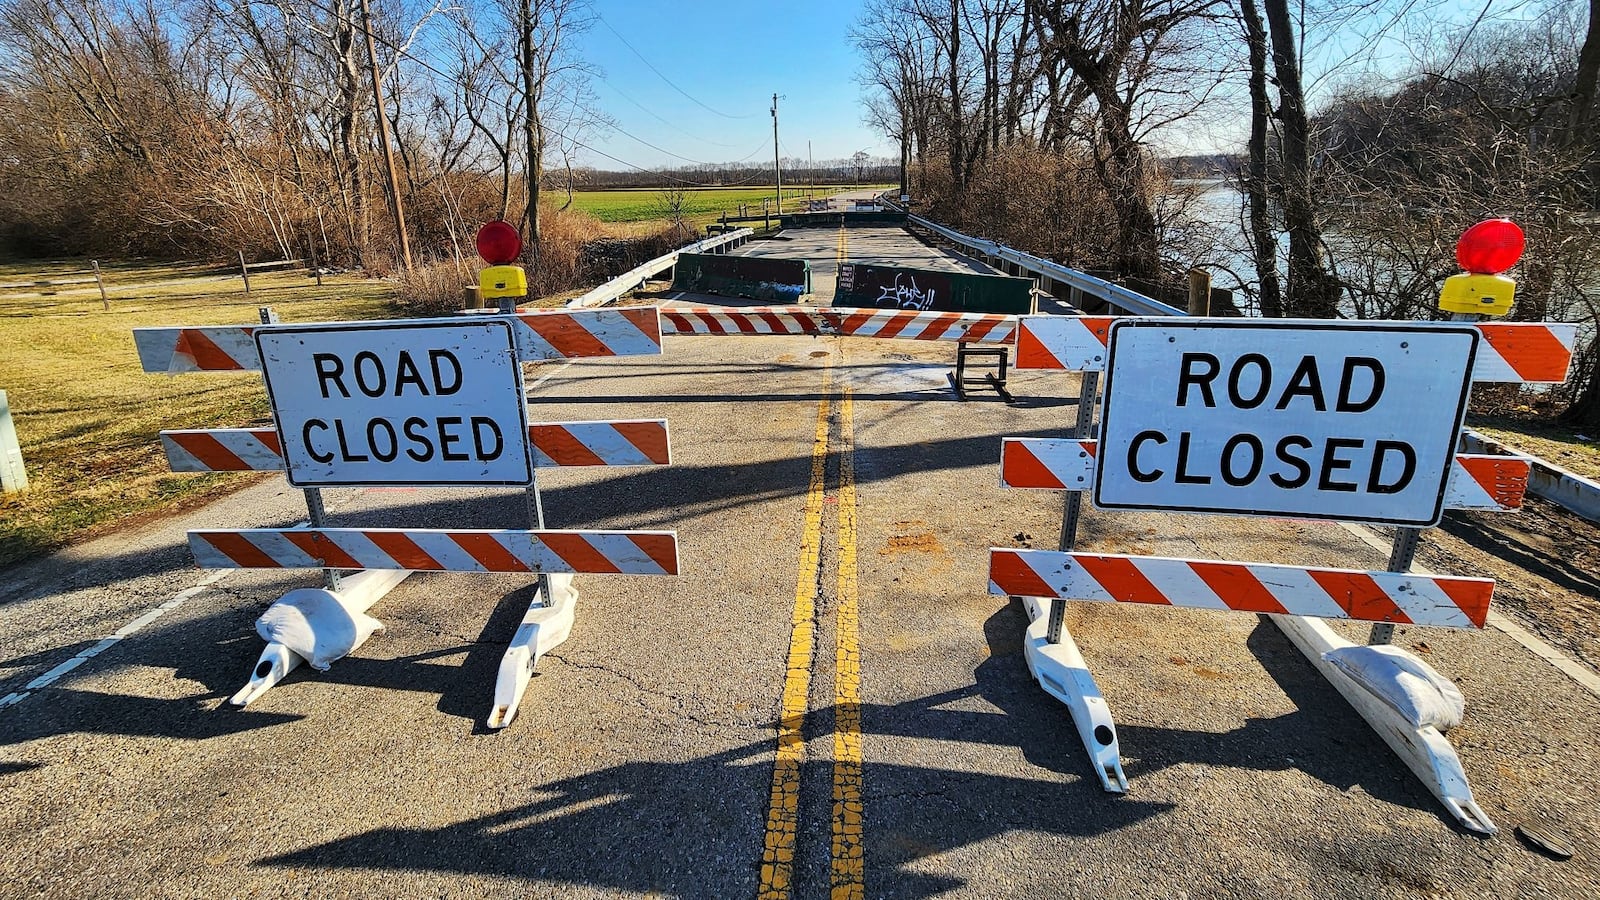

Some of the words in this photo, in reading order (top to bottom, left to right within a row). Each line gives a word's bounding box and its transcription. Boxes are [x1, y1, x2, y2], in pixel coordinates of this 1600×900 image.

[312, 348, 463, 399] ROAD
[1175, 352, 1386, 413] ROAD
[302, 416, 504, 464] CLOSED
[1127, 430, 1417, 495] CLOSED
